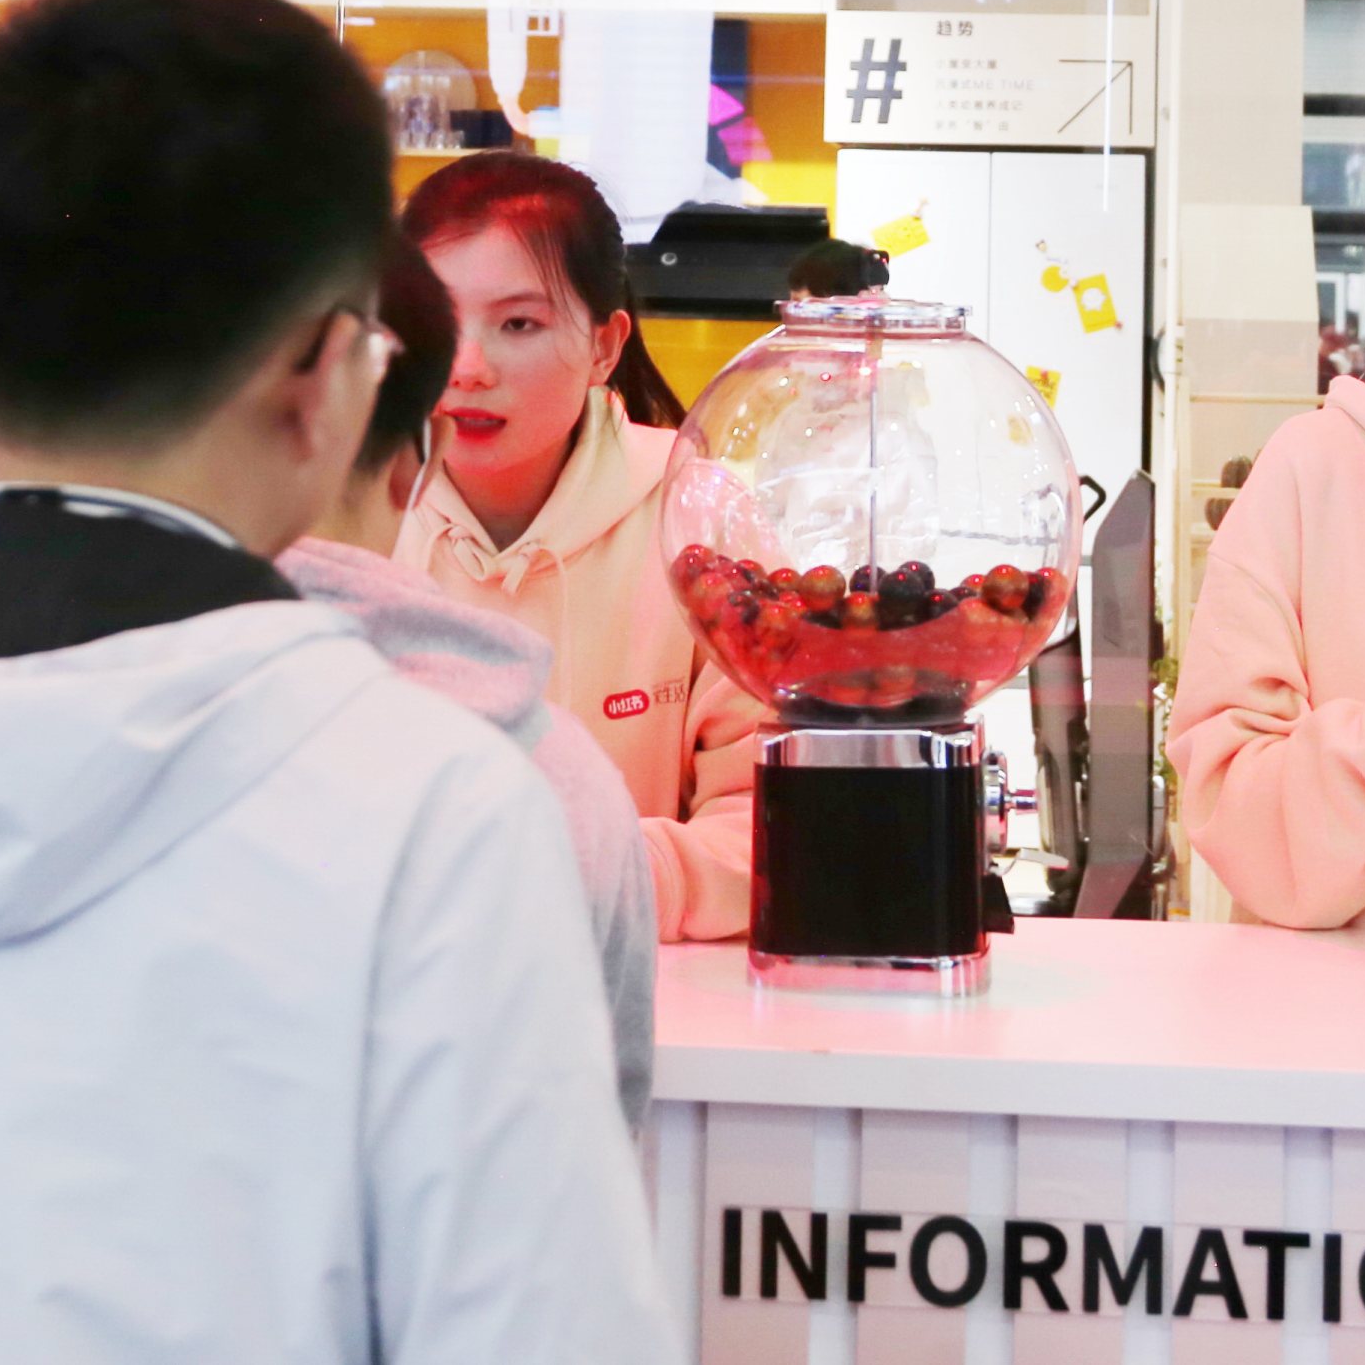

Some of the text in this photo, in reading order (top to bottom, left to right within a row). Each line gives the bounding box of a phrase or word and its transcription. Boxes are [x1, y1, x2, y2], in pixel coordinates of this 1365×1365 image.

[935, 20, 974, 37] 趋势
[609, 695, 644, 714] 小红书
